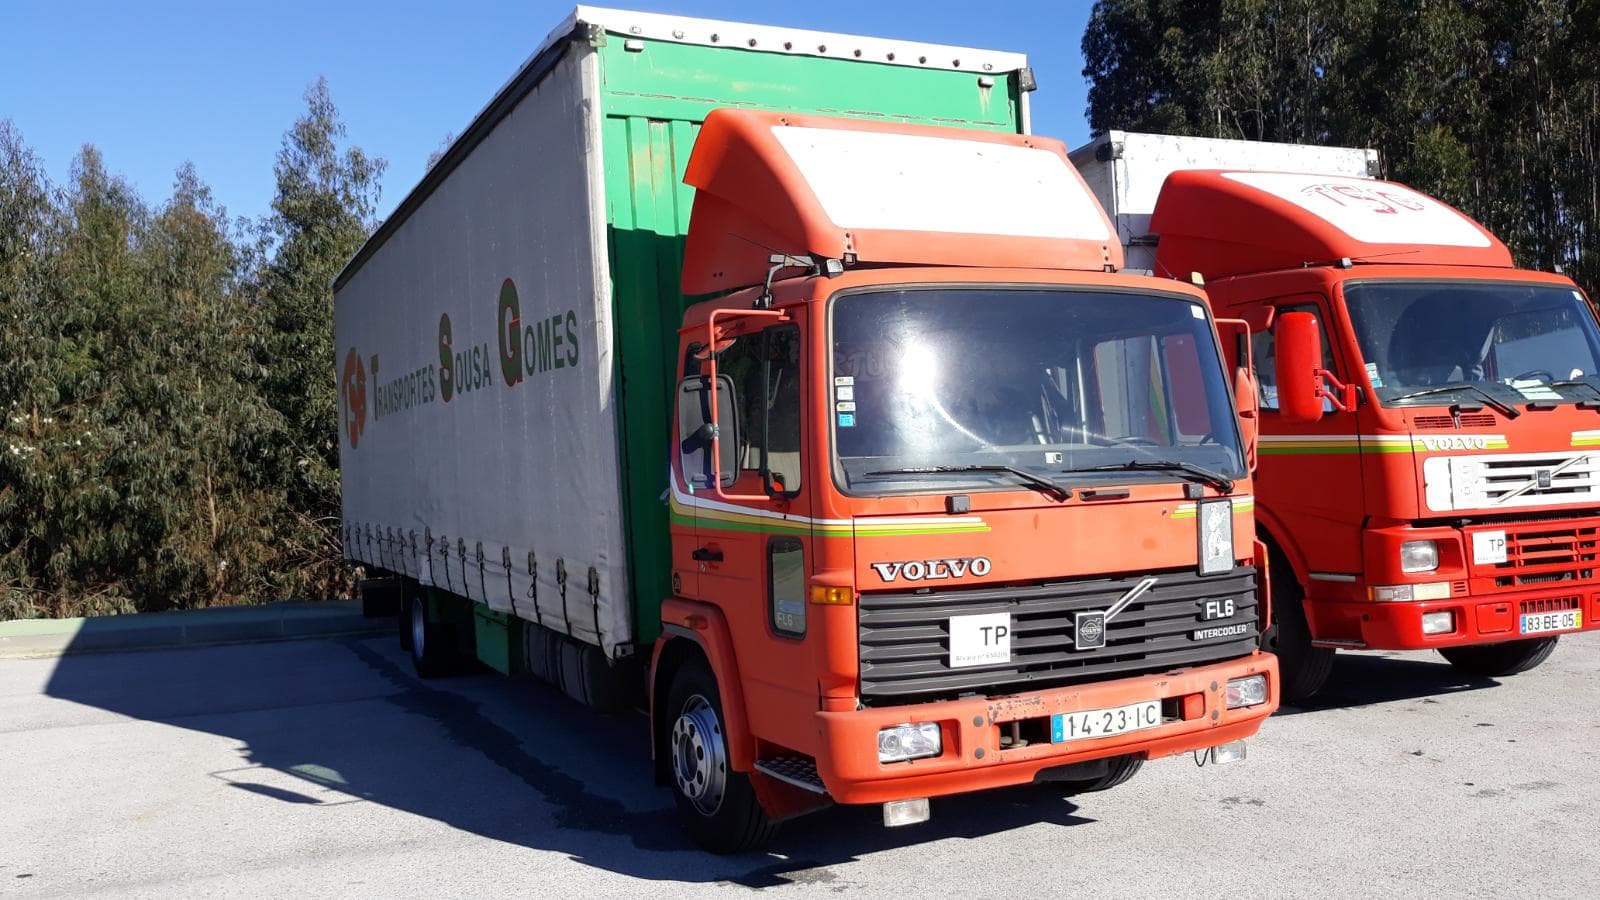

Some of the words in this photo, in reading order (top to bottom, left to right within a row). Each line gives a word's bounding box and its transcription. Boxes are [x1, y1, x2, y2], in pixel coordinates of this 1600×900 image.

[370, 354, 436, 421] TRANSPORTES
[438, 312, 492, 403] SOUSA
[498, 277, 578, 388] GOMES
[1418, 436, 1487, 451] VOLVO
[1489, 539, 1505, 552] TP
[871, 558, 992, 582] VOLVO
[1206, 599, 1235, 620] FL6
[979, 625, 1009, 647] TP
[1193, 625, 1248, 641] INTERCOOLER
